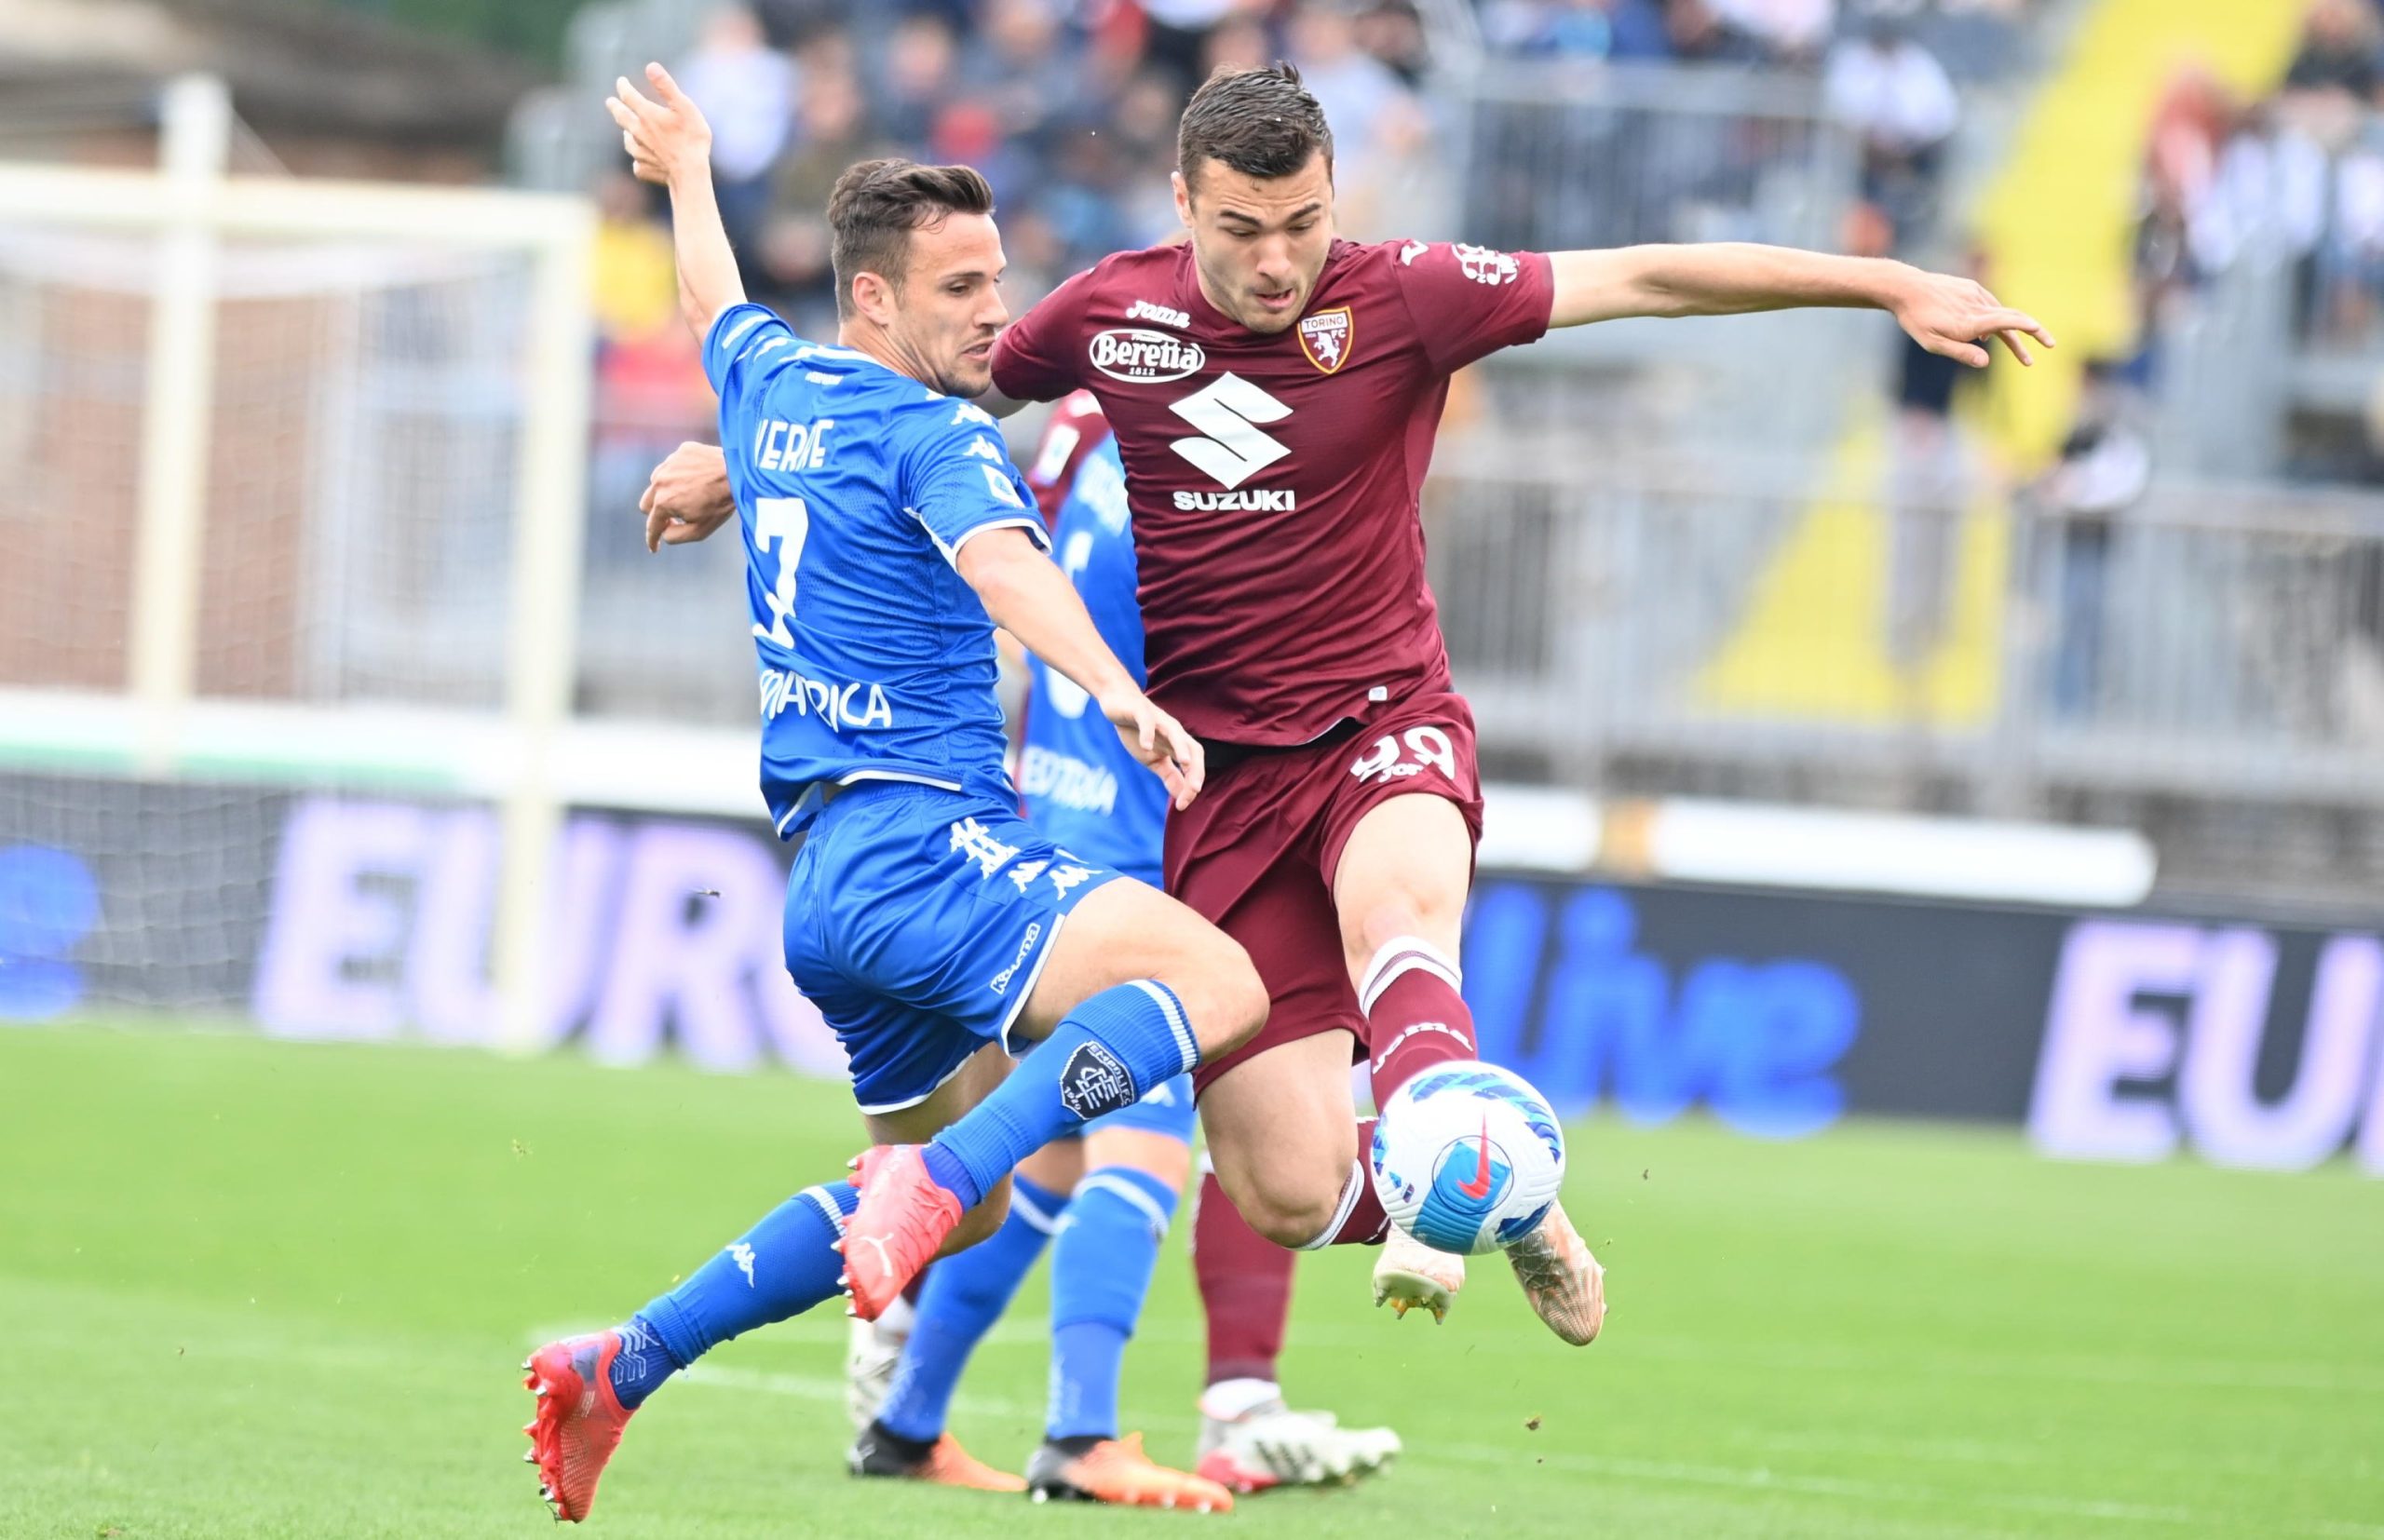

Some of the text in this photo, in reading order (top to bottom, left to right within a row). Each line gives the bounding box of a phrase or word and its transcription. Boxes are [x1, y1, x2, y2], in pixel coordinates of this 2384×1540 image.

[1303, 315, 1345, 330] TORINO
[1097, 334, 1199, 371] Beretta
[1128, 367, 1156, 377] 1812
[1172, 489, 1296, 512] SUZUKI
[752, 496, 809, 649] 7
